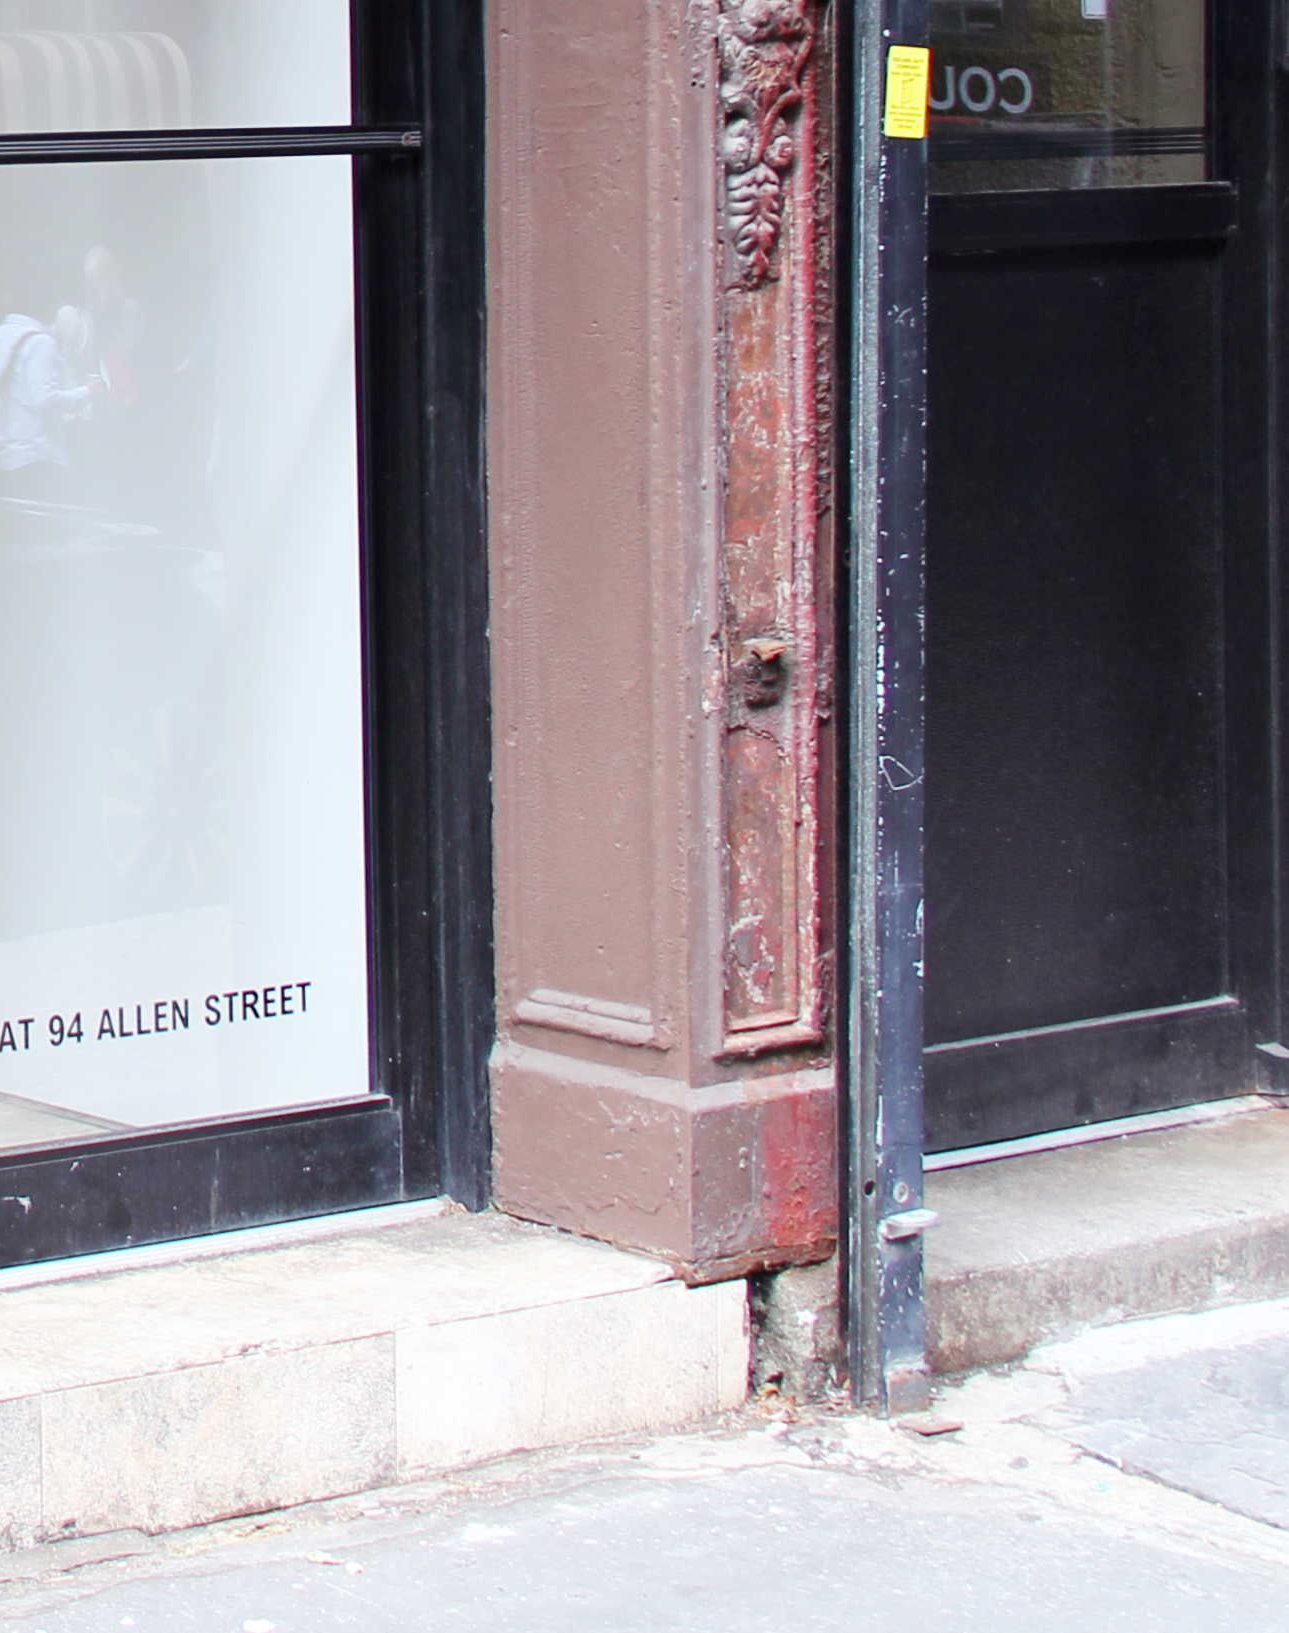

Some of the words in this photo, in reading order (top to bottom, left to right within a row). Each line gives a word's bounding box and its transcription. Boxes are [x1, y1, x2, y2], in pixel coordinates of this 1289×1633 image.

[48, 1013, 85, 1048] 94
[97, 999, 190, 1041] ALLEN
[204, 981, 313, 1027] STREET
